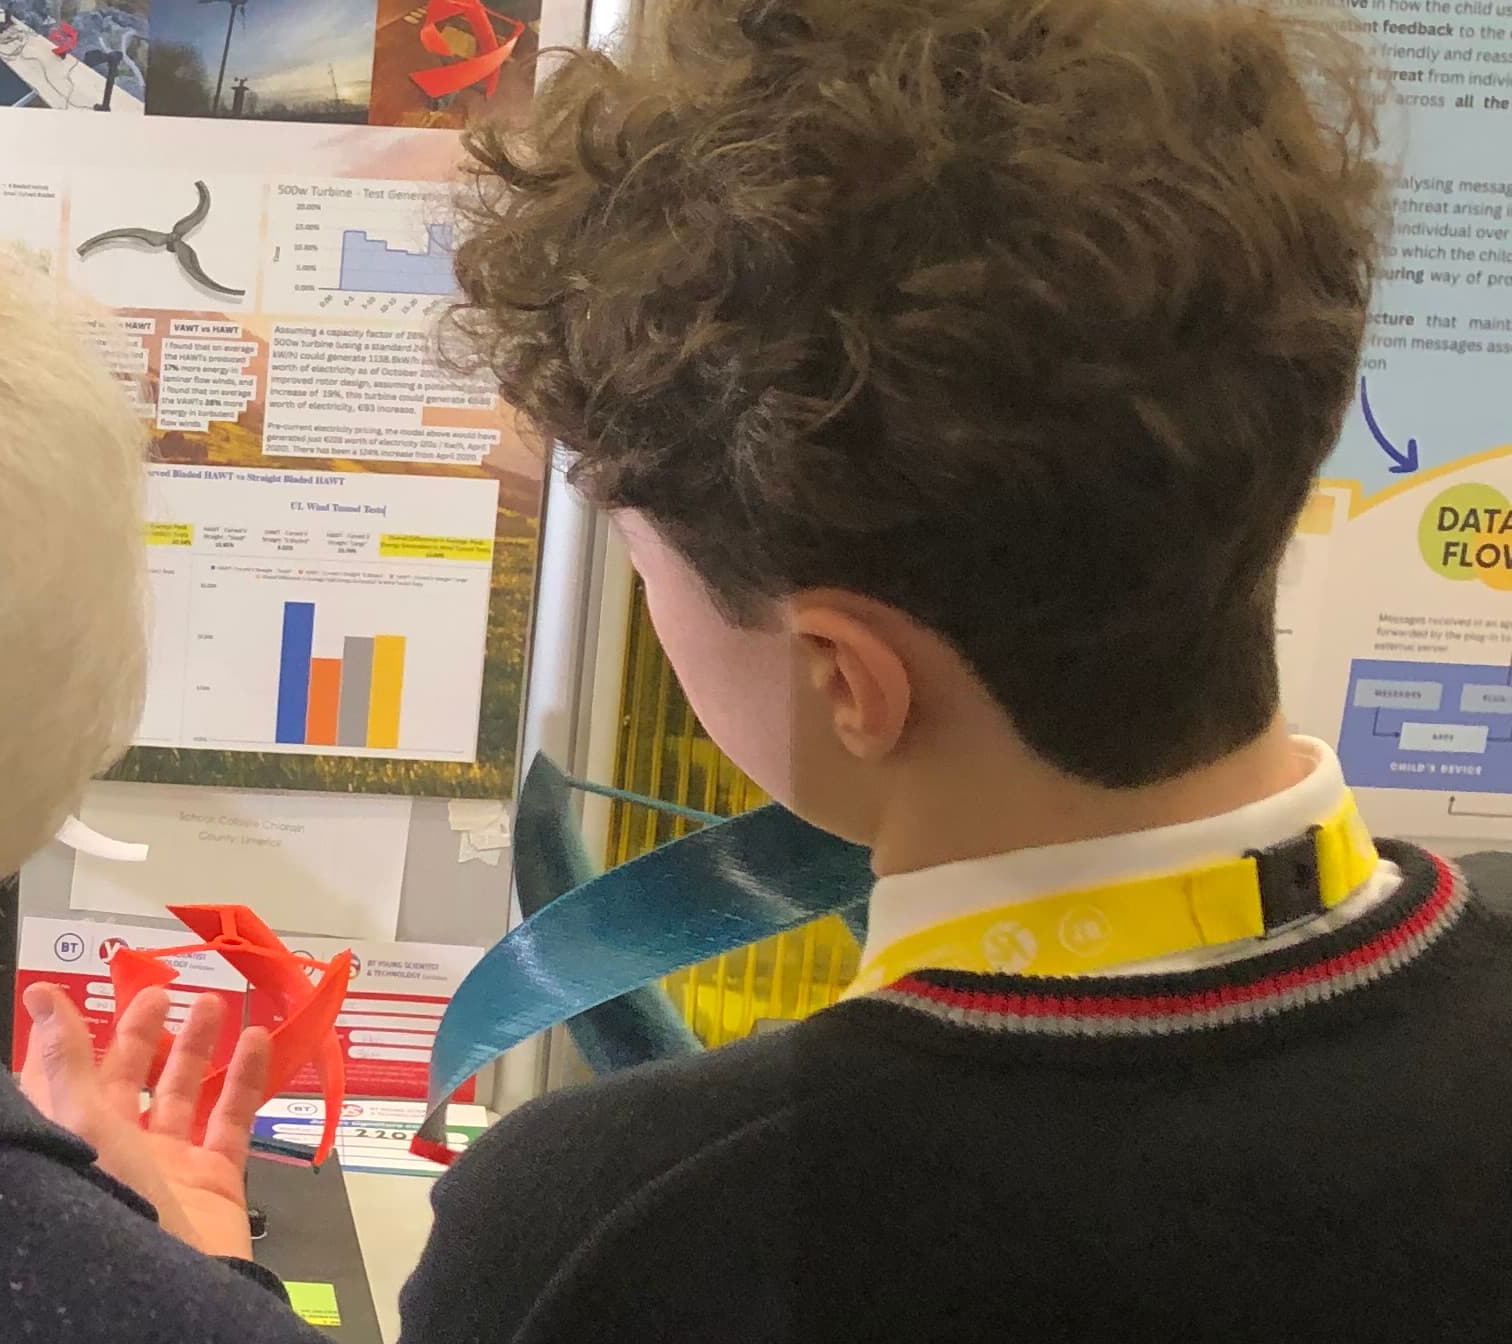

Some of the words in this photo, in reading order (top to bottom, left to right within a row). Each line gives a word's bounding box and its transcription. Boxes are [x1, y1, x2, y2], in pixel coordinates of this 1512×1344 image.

[311, 186, 352, 198] Turbine
[363, 188, 385, 200] Test
[174, 324, 200, 332] VAWT
[213, 326, 239, 334] HAWT
[61, 942, 78, 953] BT
[355, 1128, 414, 1141] 220
